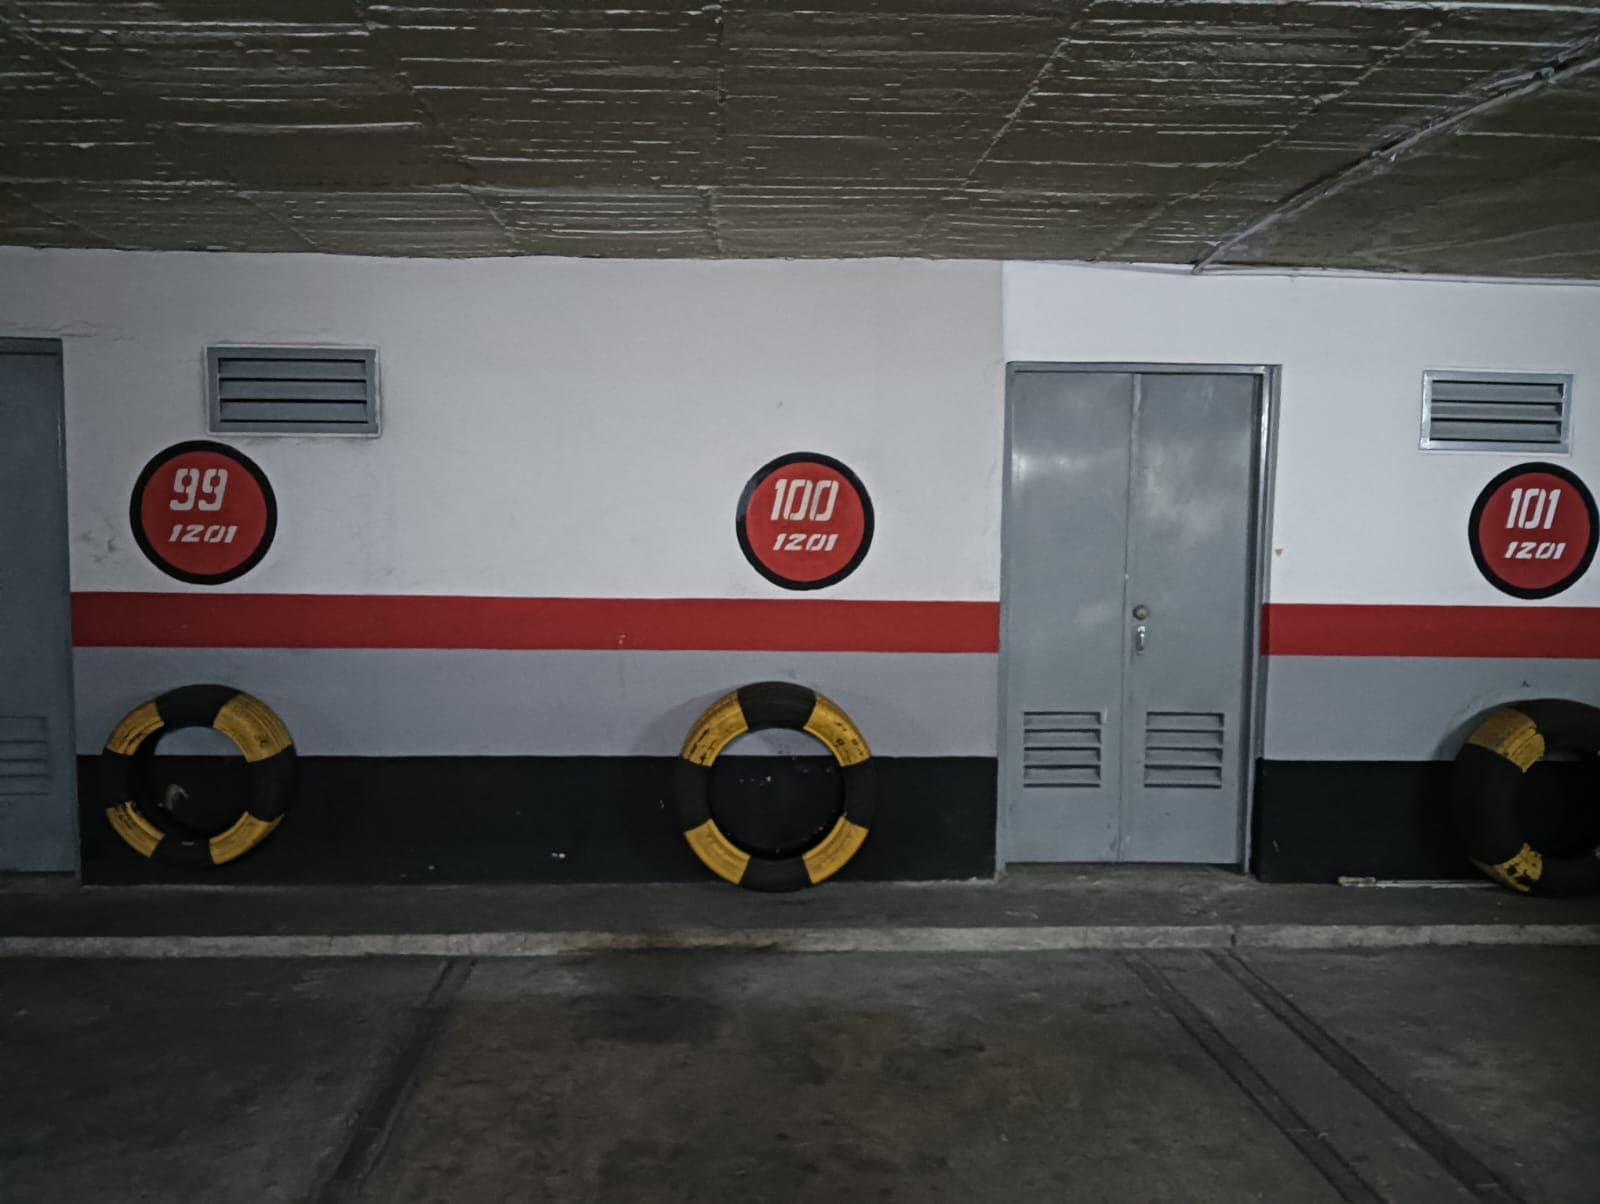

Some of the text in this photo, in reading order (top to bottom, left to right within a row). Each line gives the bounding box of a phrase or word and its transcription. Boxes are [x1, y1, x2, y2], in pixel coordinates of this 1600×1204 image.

[169, 467, 228, 511] 99
[769, 478, 839, 522] 100
[1505, 487, 1561, 530] 101
[169, 525, 238, 543] 1201
[771, 533, 839, 552] 1201
[1503, 541, 1566, 560] 1201
